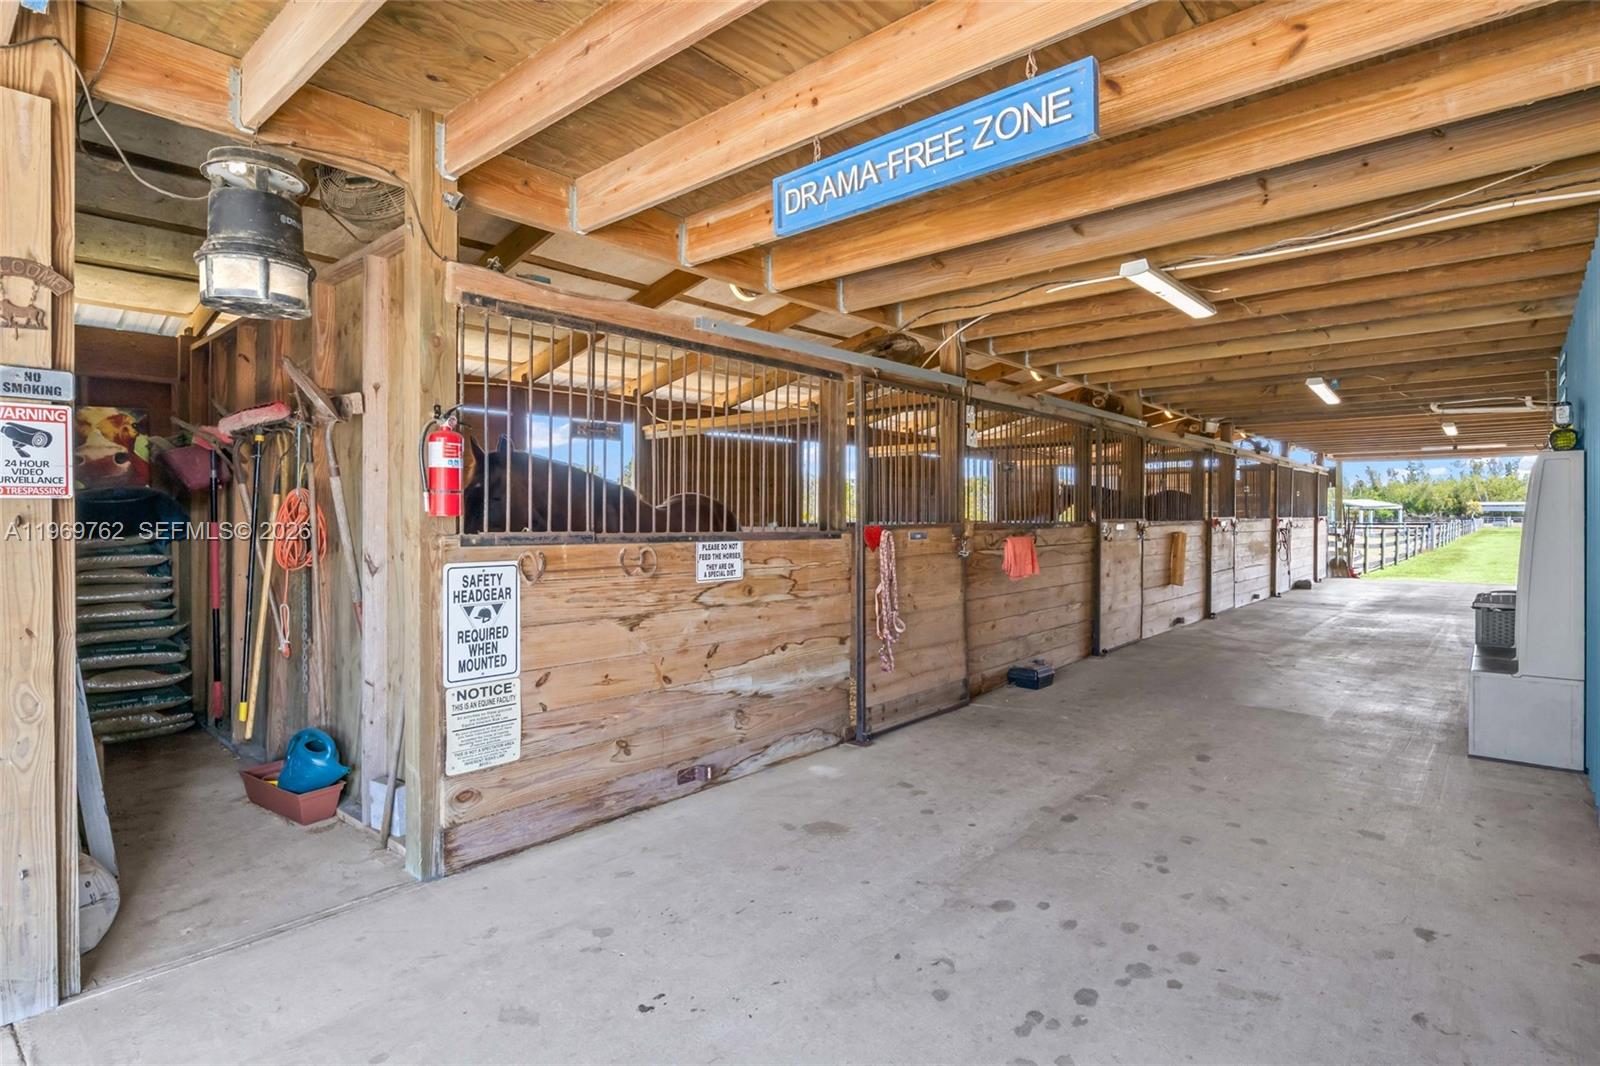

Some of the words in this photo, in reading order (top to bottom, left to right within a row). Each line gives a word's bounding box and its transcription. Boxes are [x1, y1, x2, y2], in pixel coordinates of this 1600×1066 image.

[784, 125, 966, 216] DRAMA-FREE
[972, 87, 1074, 151] ZONE
[24, 371, 42, 382] NO
[2, 382, 62, 396] SMOKING
[0, 407, 67, 422] ARNING
[4, 459, 17, 467] 24
[19, 460, 50, 468] HOUR
[11, 468, 44, 476] VIDEO
[6, 487, 65, 495] TRESPASSING
[462, 573, 503, 588] SAFETY
[453, 587, 512, 604] HEADGEAR
[457, 626, 509, 644] REQUIRED
[468, 641, 498, 657] WHEN
[458, 654, 507, 673] MOUNTED
[456, 682, 512, 701] NOTICE
[452, 703, 463, 712] THIS
[478, 697, 496, 707] EQUINE
[496, 694, 516, 704] FACILITY
